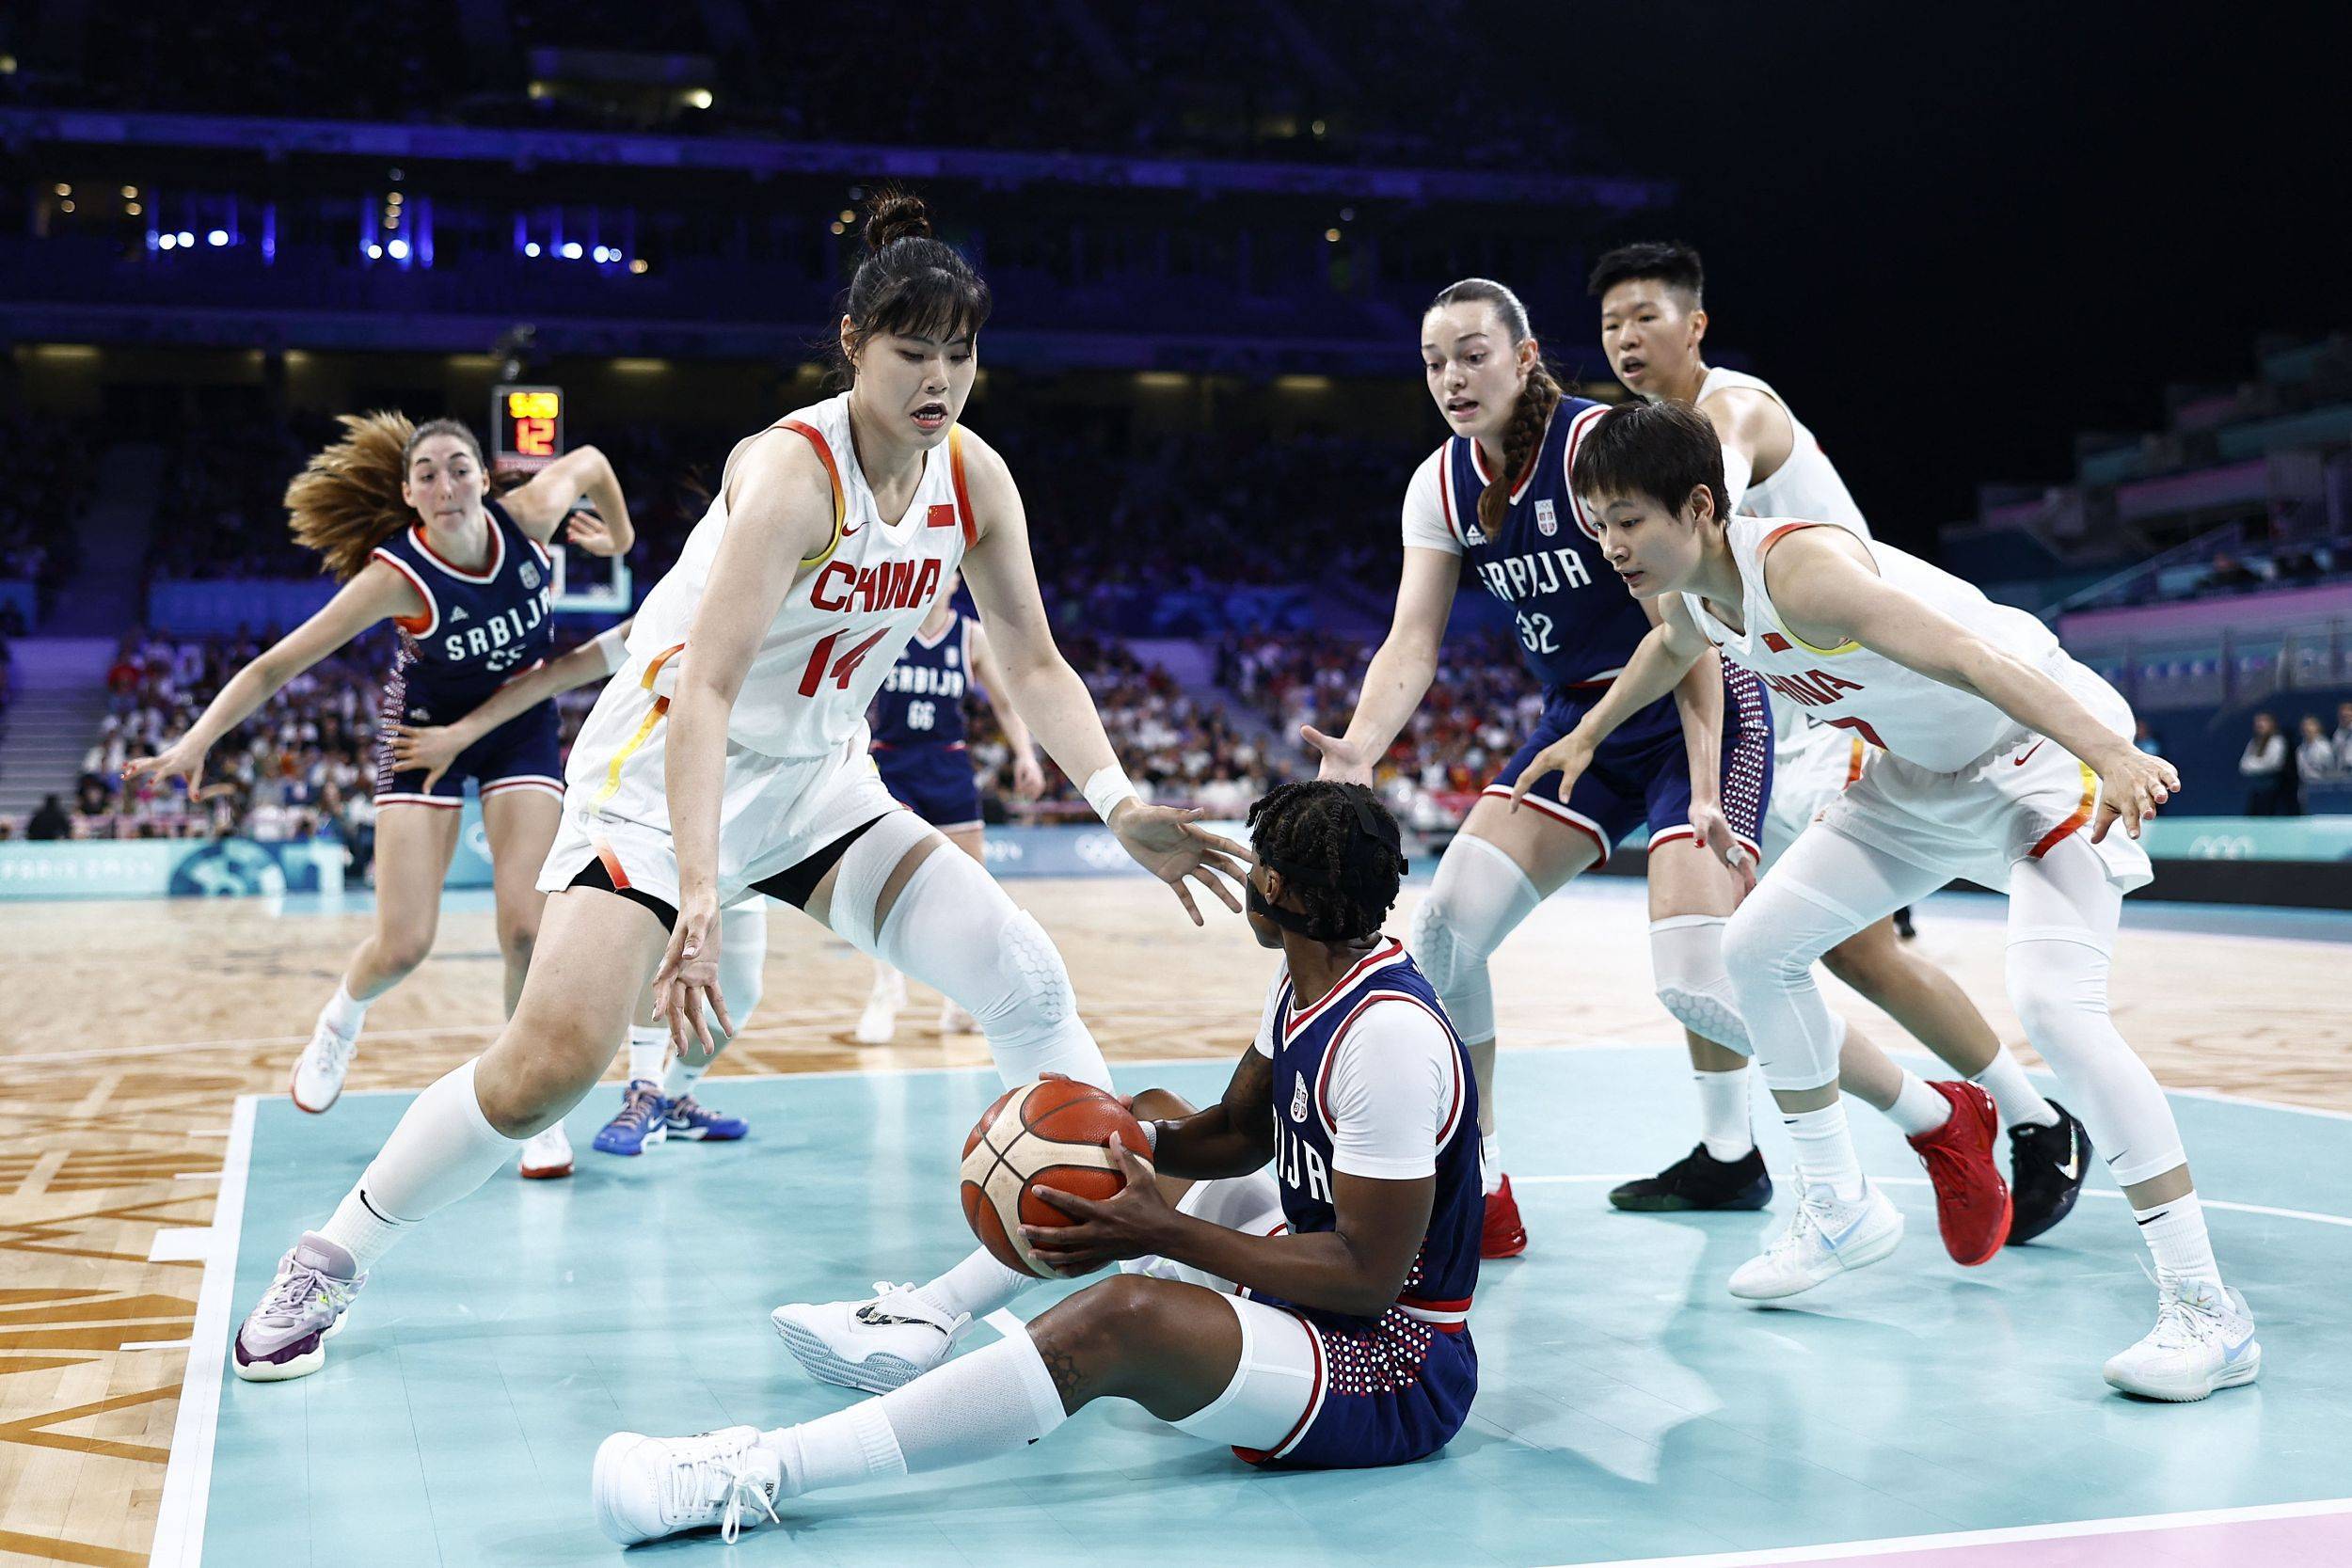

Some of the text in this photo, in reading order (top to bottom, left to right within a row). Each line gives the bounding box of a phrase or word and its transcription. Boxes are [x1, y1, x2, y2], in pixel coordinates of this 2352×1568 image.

[516, 420, 555, 456] 12
[810, 559, 941, 612] CHINA
[1516, 610, 1560, 654] 32
[798, 626, 892, 697] 14
[1754, 669, 1866, 706] HINA
